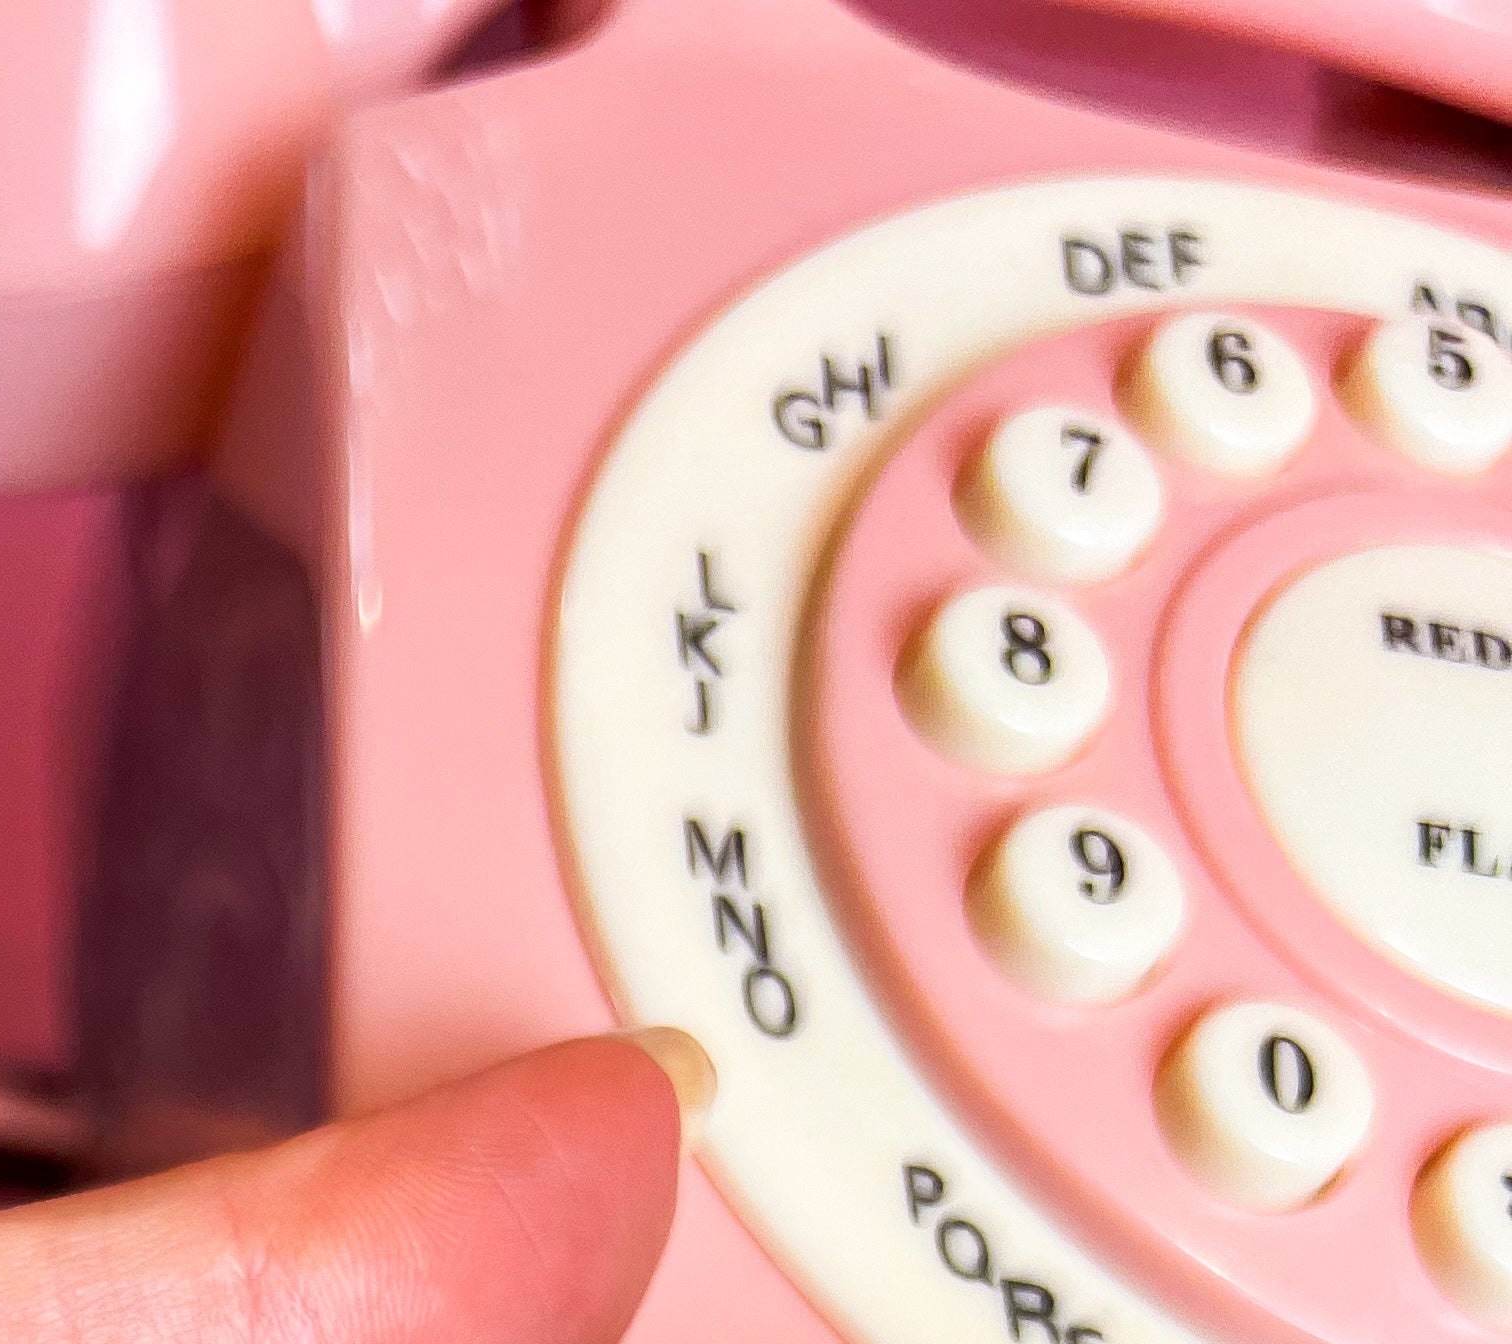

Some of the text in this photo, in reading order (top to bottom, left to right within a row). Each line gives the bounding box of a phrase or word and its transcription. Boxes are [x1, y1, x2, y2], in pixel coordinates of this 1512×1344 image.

[1062, 231, 1202, 297] DEF
[1206, 331, 1259, 394] 6
[1427, 325, 1475, 391] 5
[773, 335, 896, 452] GHI
[1061, 427, 1105, 494] 7
[999, 612, 1053, 686] 8
[1069, 829, 1128, 904] 9
[1416, 821, 1512, 880] FL
[684, 818, 798, 1040] MNO
[1258, 1034, 1316, 1114] 0
